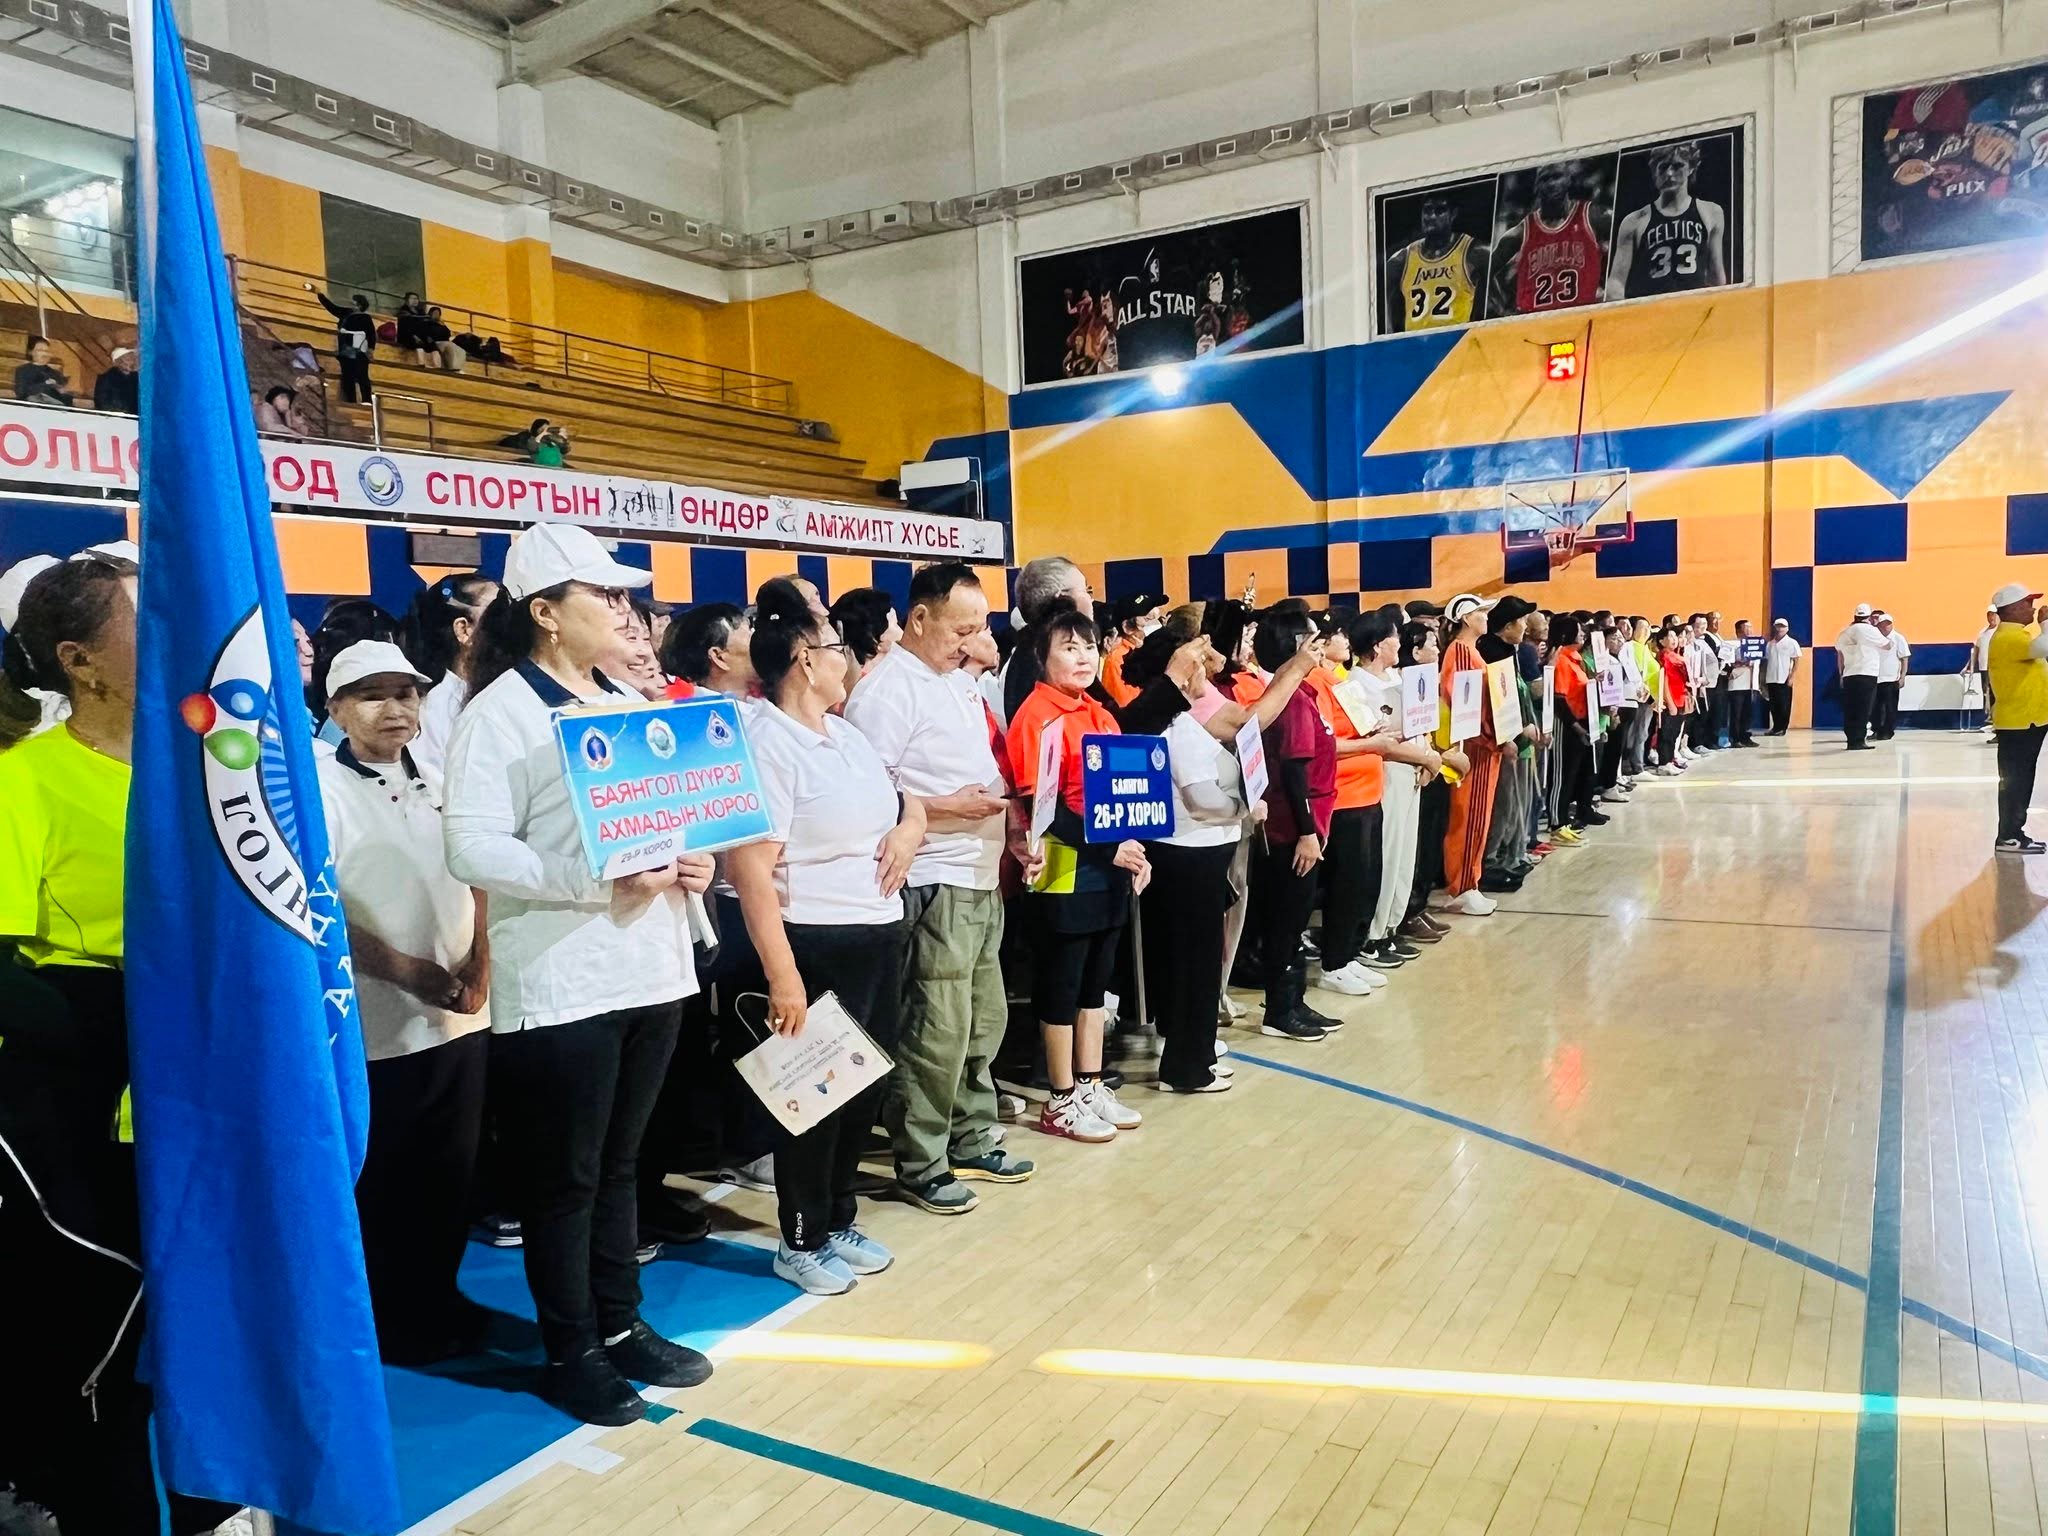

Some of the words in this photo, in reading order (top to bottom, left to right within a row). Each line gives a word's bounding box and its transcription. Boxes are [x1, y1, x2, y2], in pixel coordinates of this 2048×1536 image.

[1647, 219, 1703, 249] CELTICS
[1649, 244, 1697, 278] 33
[1411, 286, 1455, 319] 32
[1534, 269, 1579, 309] 23
[1116, 298, 1147, 330] ALL
[1149, 290, 1196, 318] STAR
[1549, 355, 1575, 378] 24
[426, 471, 600, 517] СПОРТЫН
[681, 496, 769, 534] ӨНДӨР
[589, 774, 683, 809] БАЯНГОЛ
[685, 763, 743, 794] ДҮҮРЭГ
[599, 806, 700, 843] АХМАДЫН
[703, 792, 760, 821] ХОРОО
[1094, 802, 1124, 829] 26-Р
[1127, 801, 1167, 826] ХОРОО
